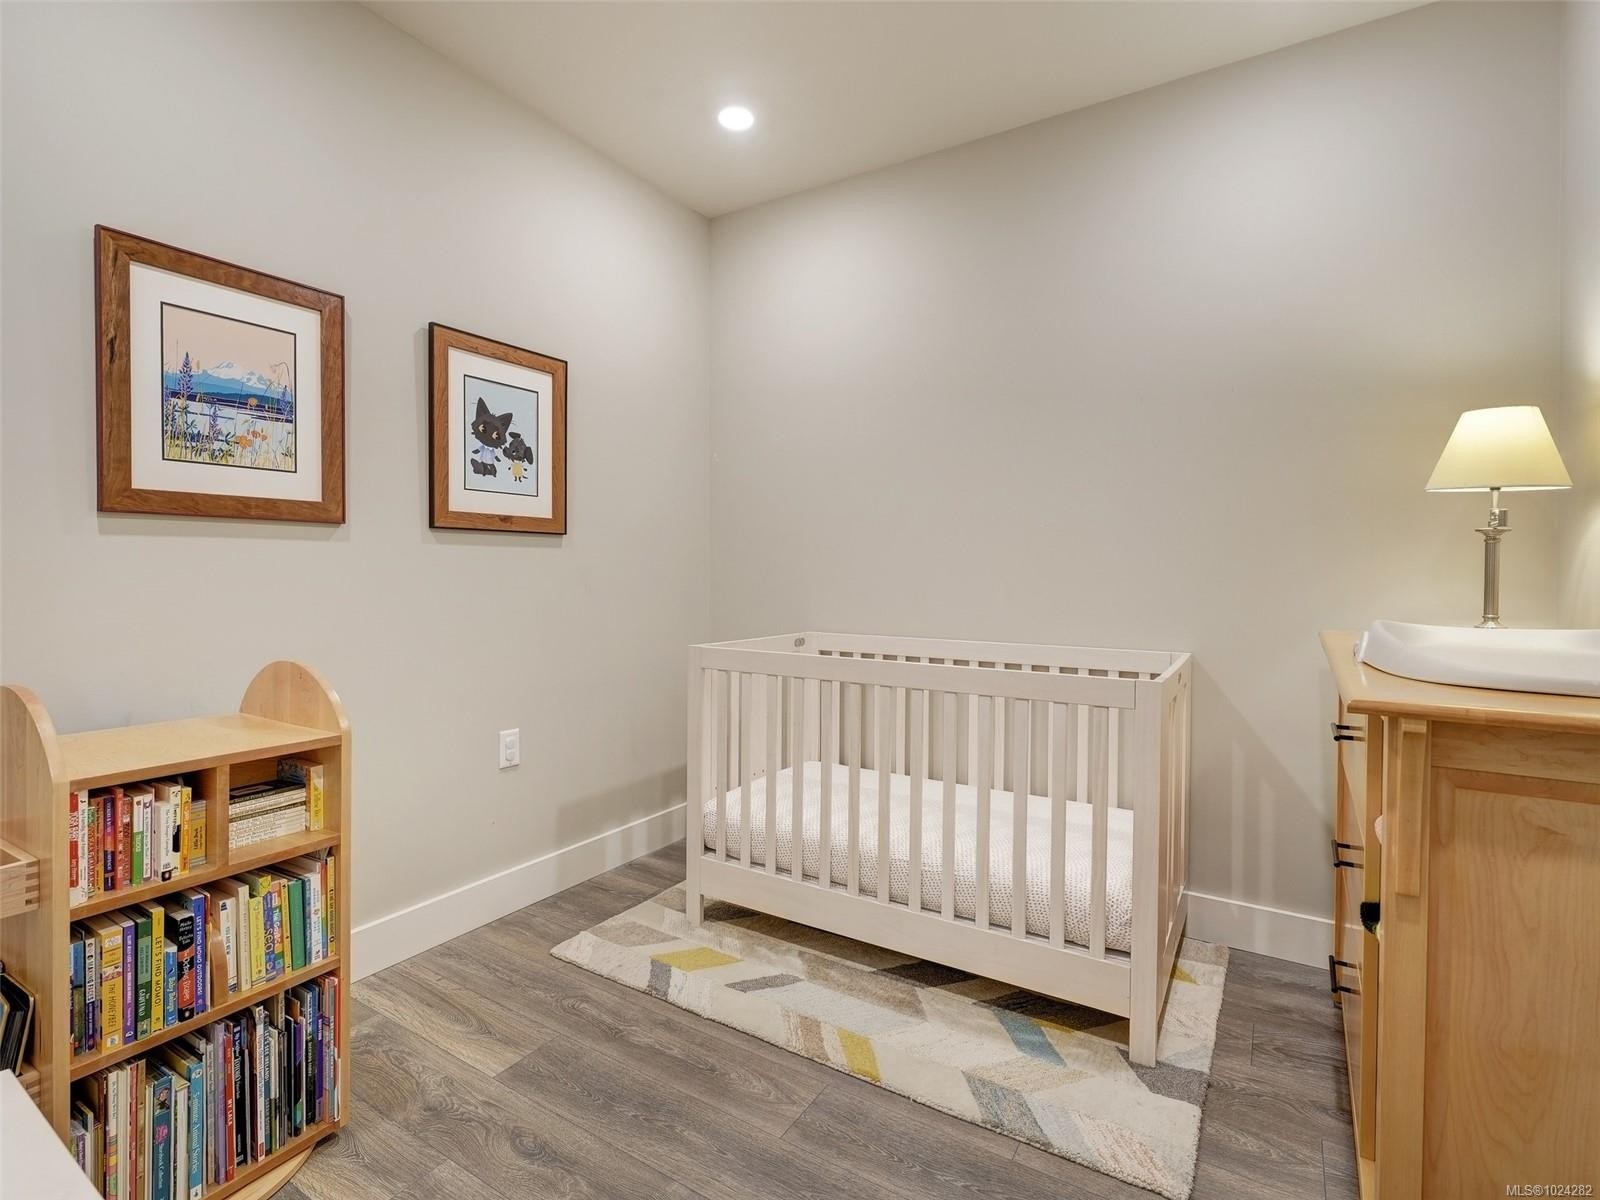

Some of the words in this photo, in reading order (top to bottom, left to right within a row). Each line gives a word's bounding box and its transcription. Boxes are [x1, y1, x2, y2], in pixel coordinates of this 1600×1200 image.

[87, 960, 96, 984] MAKING
[168, 976, 176, 992] Baby
[108, 996, 116, 1027] HONEYBEE
[192, 1123, 200, 1148] Animal
[192, 1149, 200, 1174] Stories
